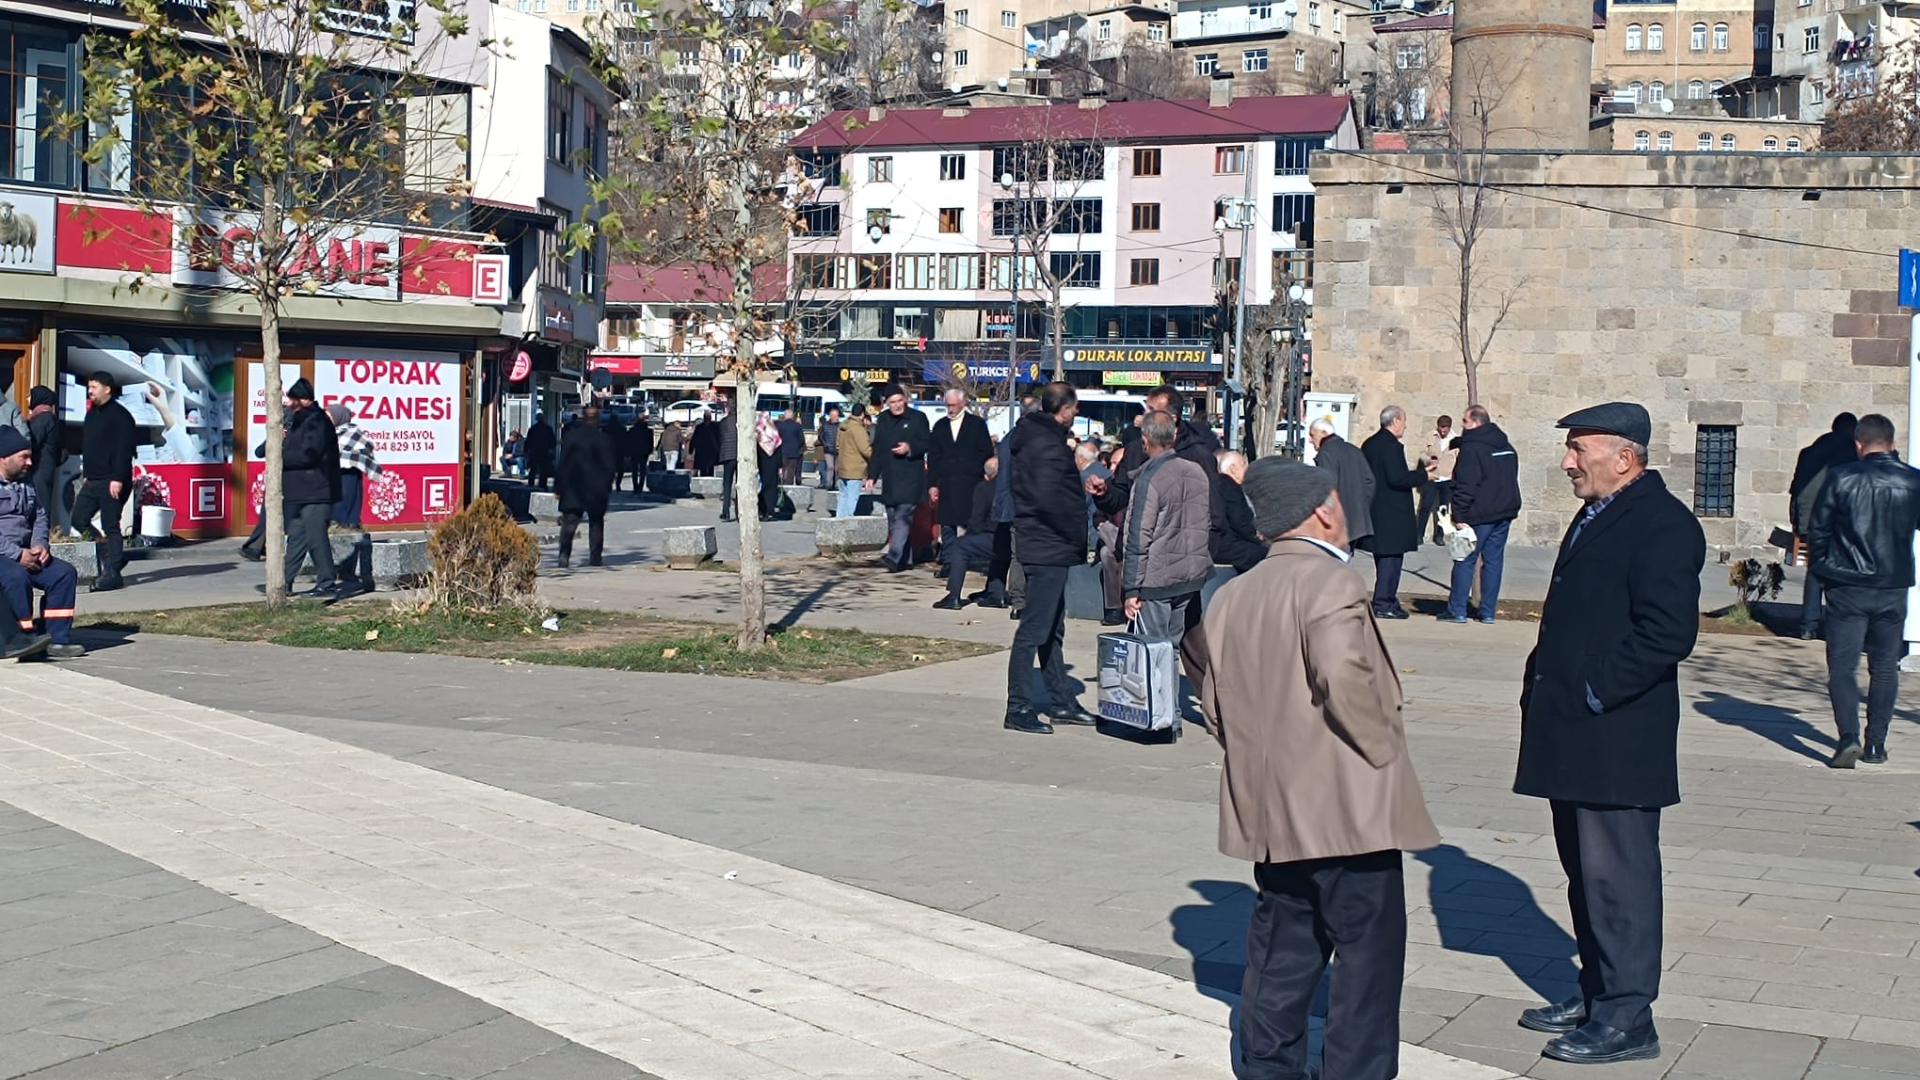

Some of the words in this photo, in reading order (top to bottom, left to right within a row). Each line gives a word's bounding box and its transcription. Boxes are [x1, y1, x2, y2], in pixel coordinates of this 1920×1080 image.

[482, 267, 497, 293] E
[1077, 350, 1125, 362] DURAK
[1128, 350, 1206, 362] LOKANTASI
[334, 358, 441, 386] TOPRAK
[390, 442, 409, 451] 829
[412, 442, 421, 451] 13
[424, 442, 434, 451] 14
[393, 430, 435, 440] KISAYOL
[199, 486, 216, 511] E
[430, 484, 445, 507] E
